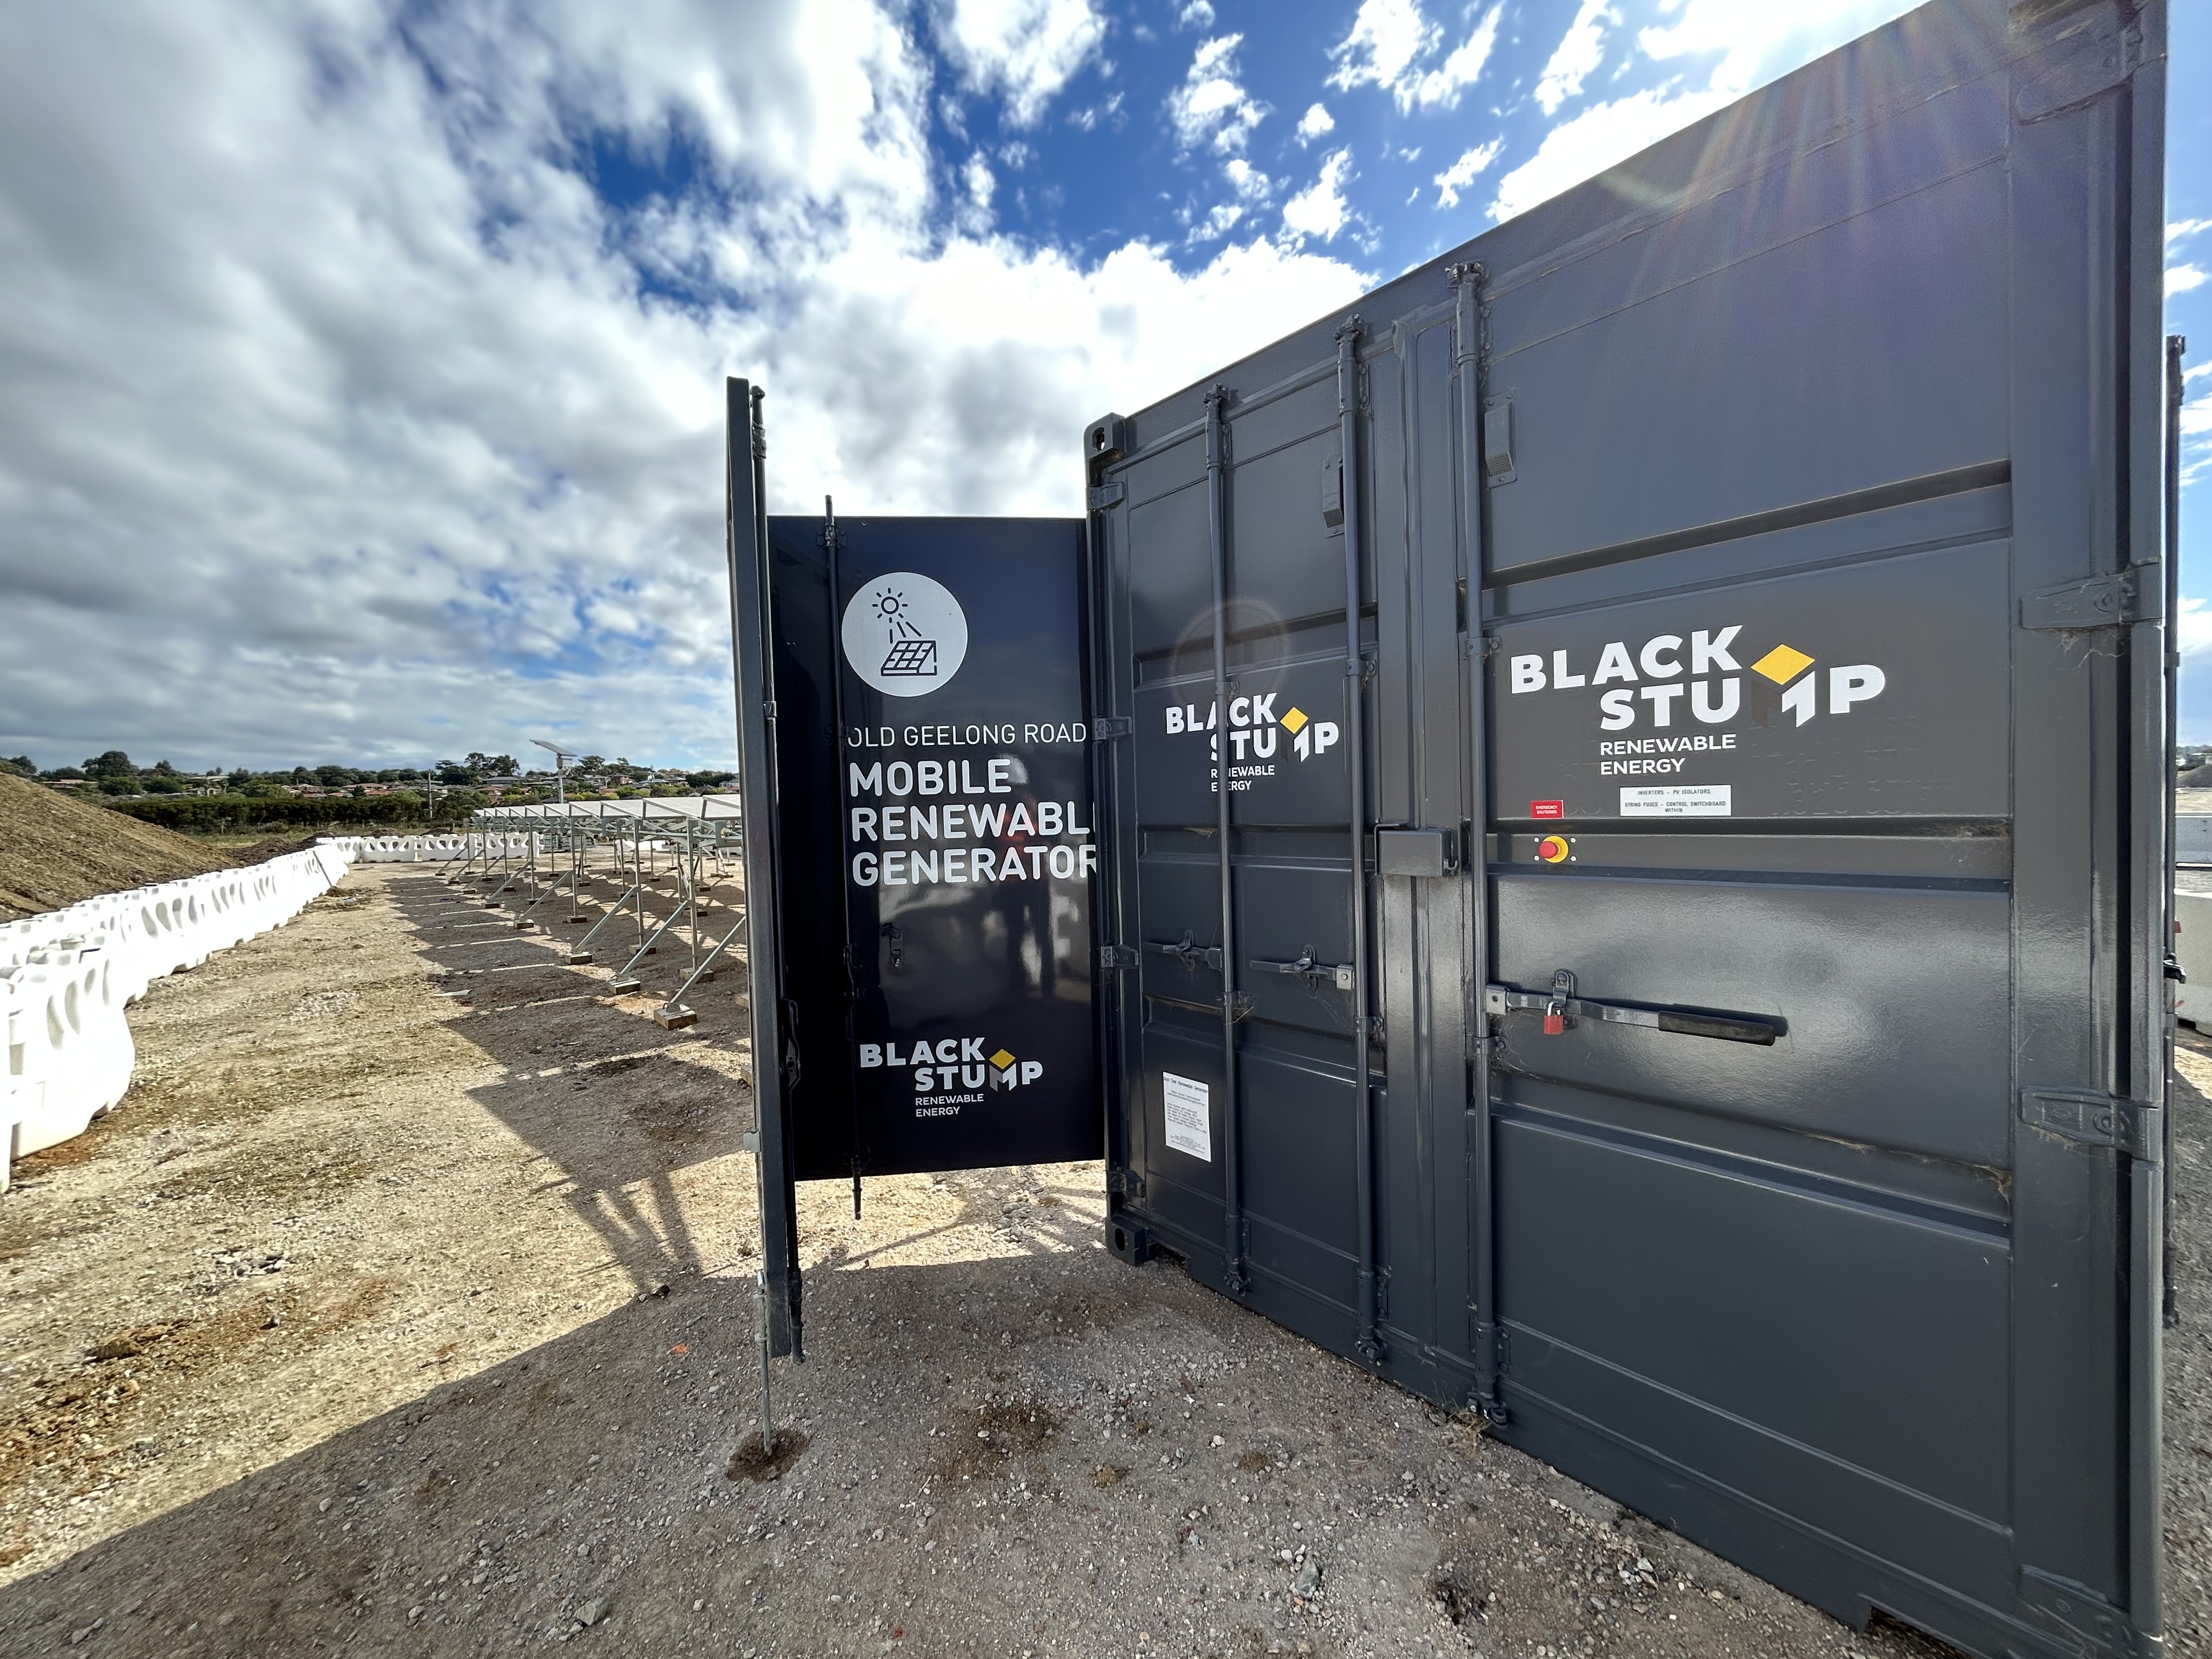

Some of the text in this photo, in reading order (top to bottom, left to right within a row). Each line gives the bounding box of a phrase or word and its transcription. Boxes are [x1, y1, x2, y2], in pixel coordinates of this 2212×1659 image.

[1510, 624, 1743, 695] BLACK
[848, 723, 1087, 747] OLD GEELONG ROAD
[1600, 733, 1737, 756] RENEWABLE
[849, 758, 1012, 797] MOBILE
[1211, 764, 1276, 778] REWABLE
[1600, 757, 1686, 776] ENERGY
[851, 801, 1096, 842] RENEWABL
[852, 844, 1097, 887] GENERATOR
[860, 1037, 985, 1068] BLACK
[914, 1061, 1043, 1092] STUMP
[915, 1093, 984, 1106] RENEWABLE
[916, 1106, 961, 1118] ENERGY
